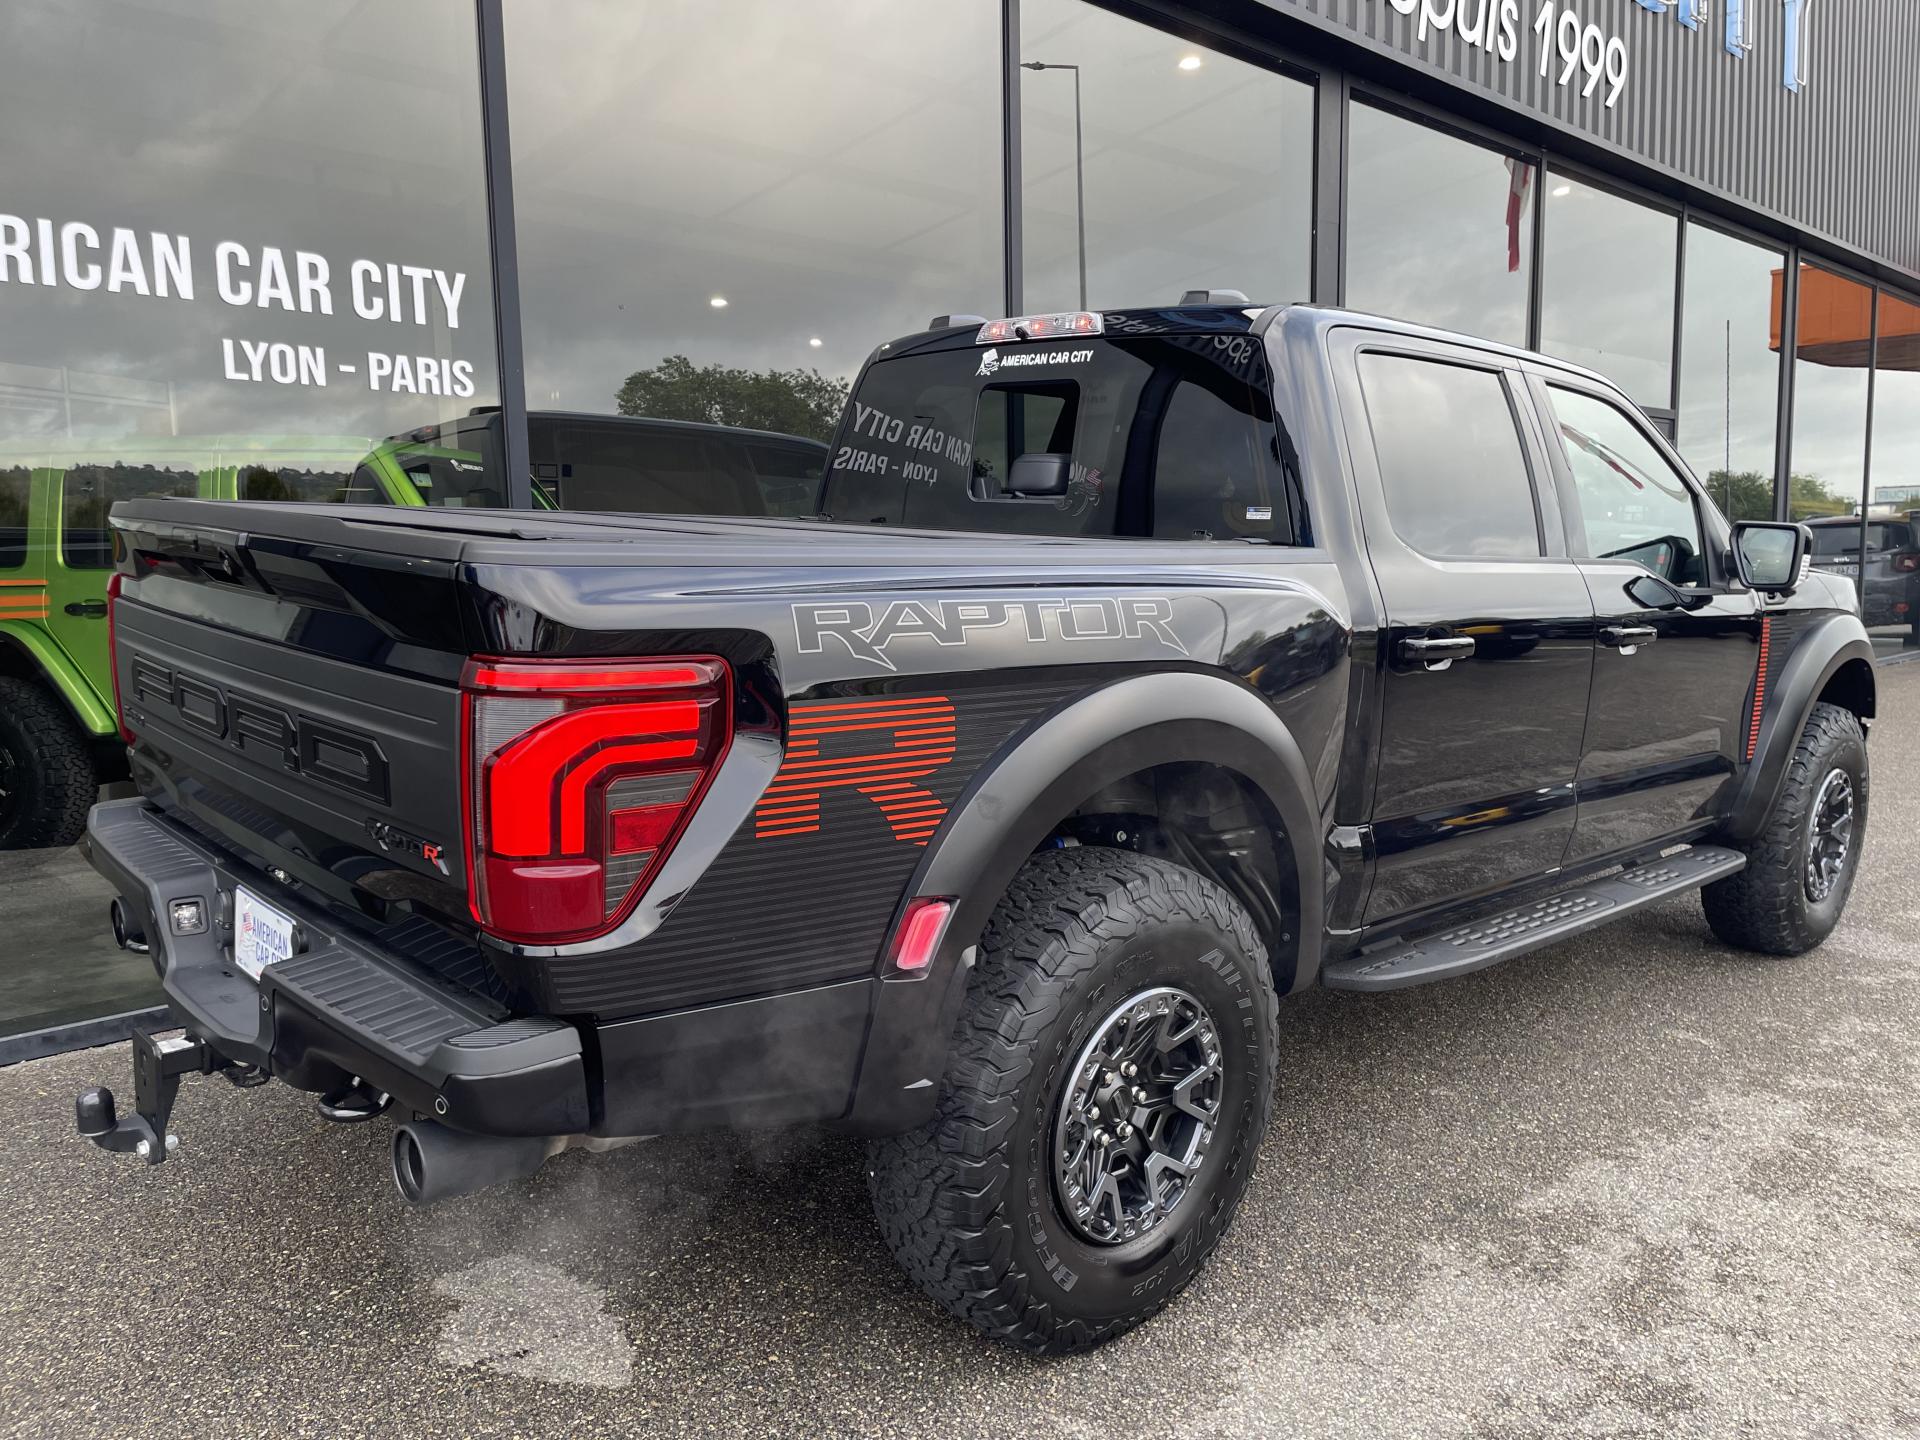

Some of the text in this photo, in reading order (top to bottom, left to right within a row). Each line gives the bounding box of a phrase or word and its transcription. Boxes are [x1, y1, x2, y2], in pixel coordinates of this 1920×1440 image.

[1533, 0, 1629, 109] 1999
[215, 241, 333, 315] CAR
[351, 260, 466, 329] CITY
[222, 338, 327, 387] LYON
[368, 352, 475, 398] PARIS
[1000, 350, 1094, 367] AMERICAN CAR CITY
[791, 597, 1190, 671] RAPTOR
[131, 654, 392, 808] FORD
[252, 916, 288, 957] AMERICAN
[255, 941, 269, 966] CAR
